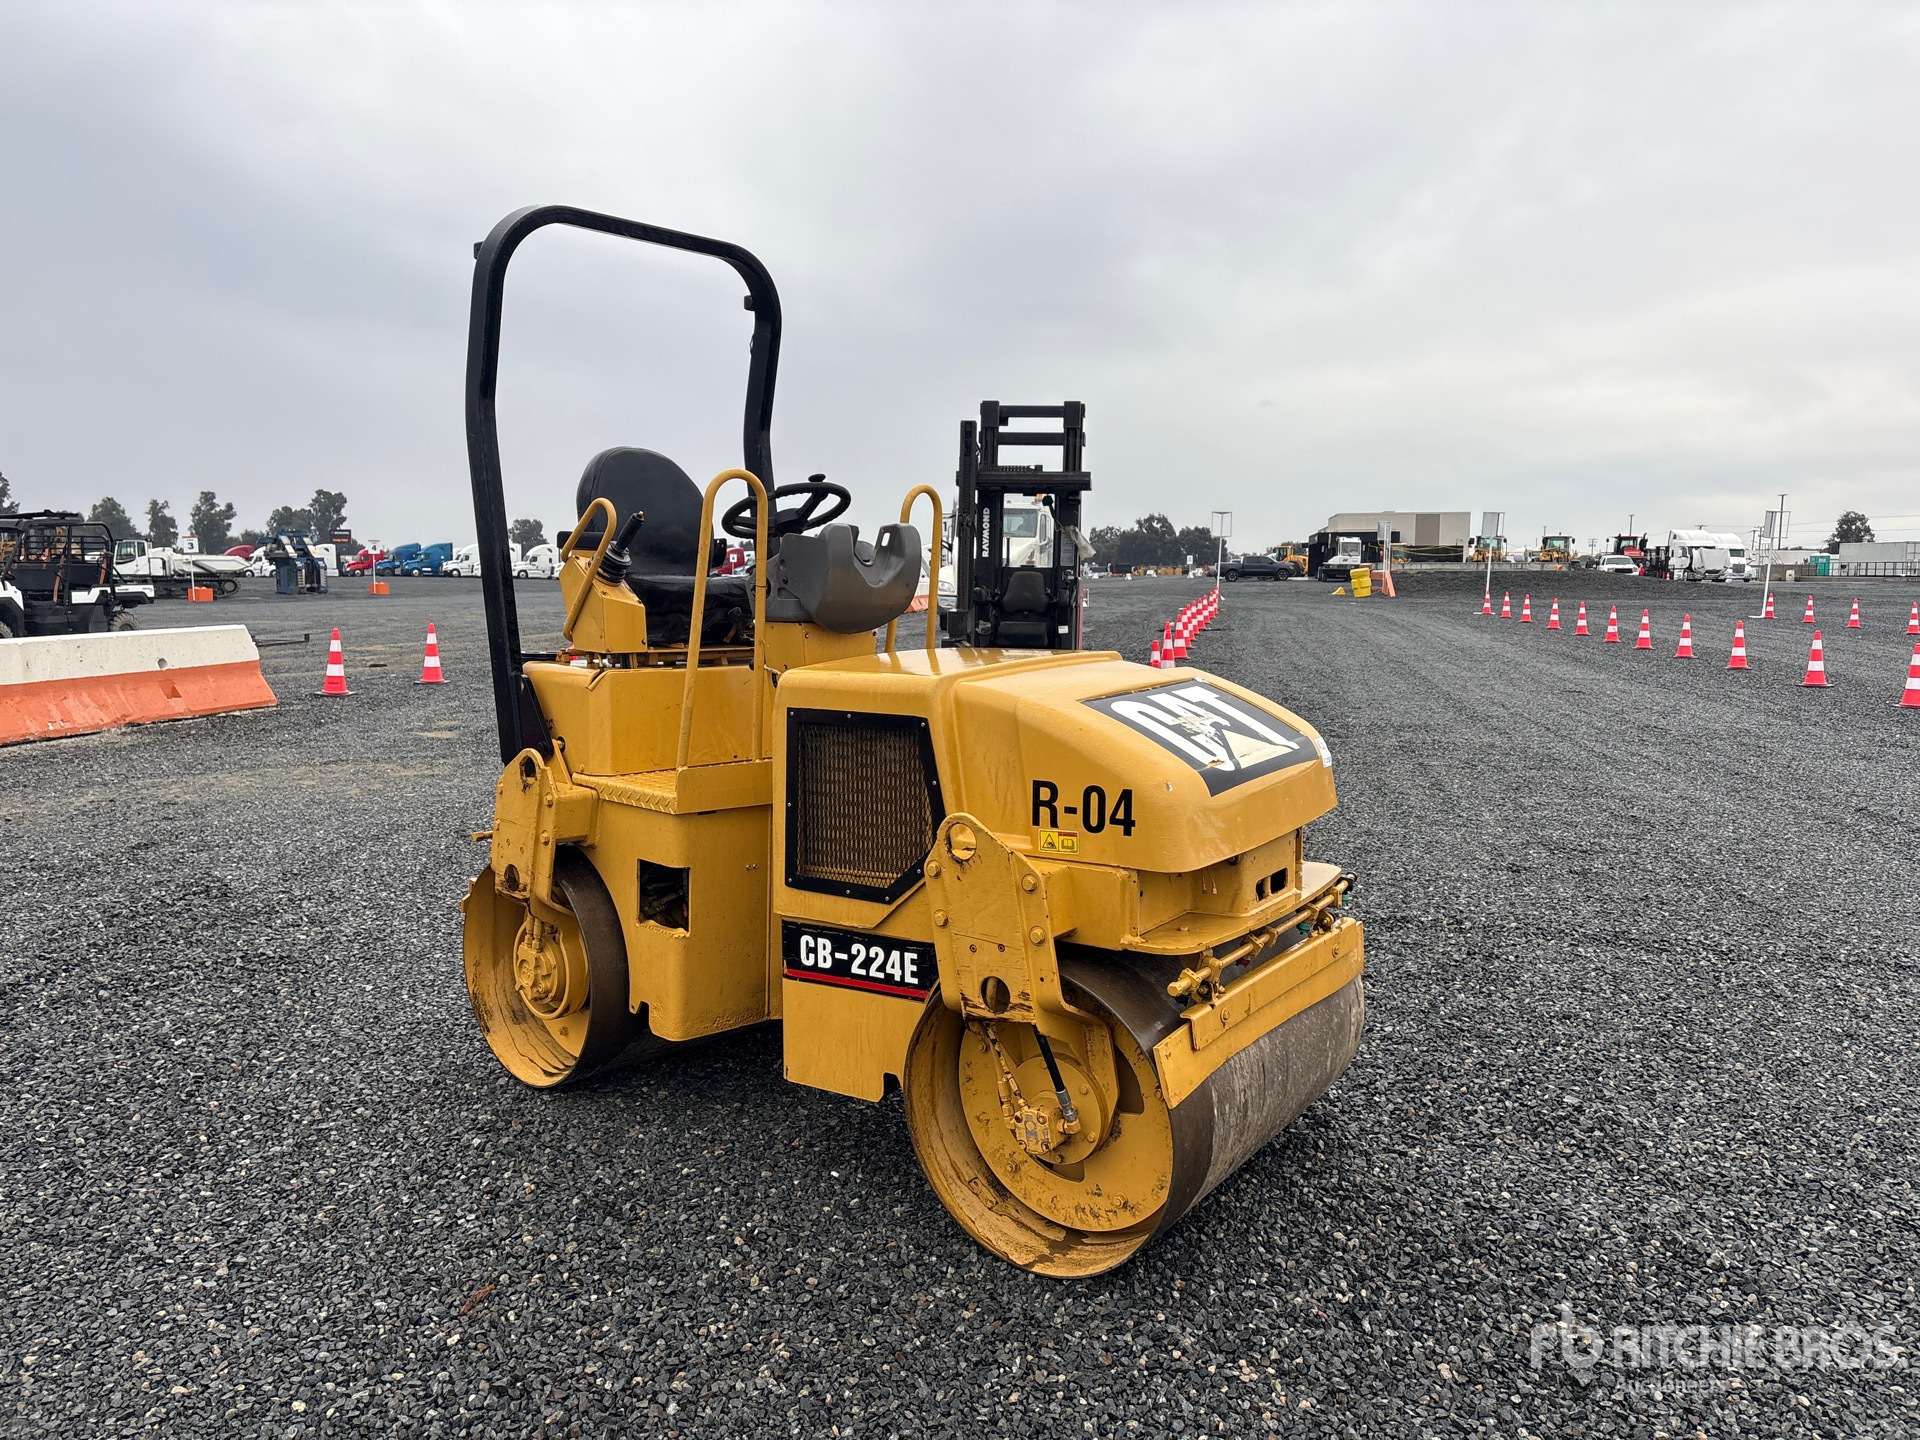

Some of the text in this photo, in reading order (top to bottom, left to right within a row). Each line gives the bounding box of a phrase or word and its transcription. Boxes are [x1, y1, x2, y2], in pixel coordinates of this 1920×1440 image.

[187, 542, 195, 550] 3
[981, 507, 991, 558] RAYMOND
[1110, 686, 1300, 771] CAT
[1031, 779, 1136, 837] R-04
[799, 934, 919, 985] CB-224E
